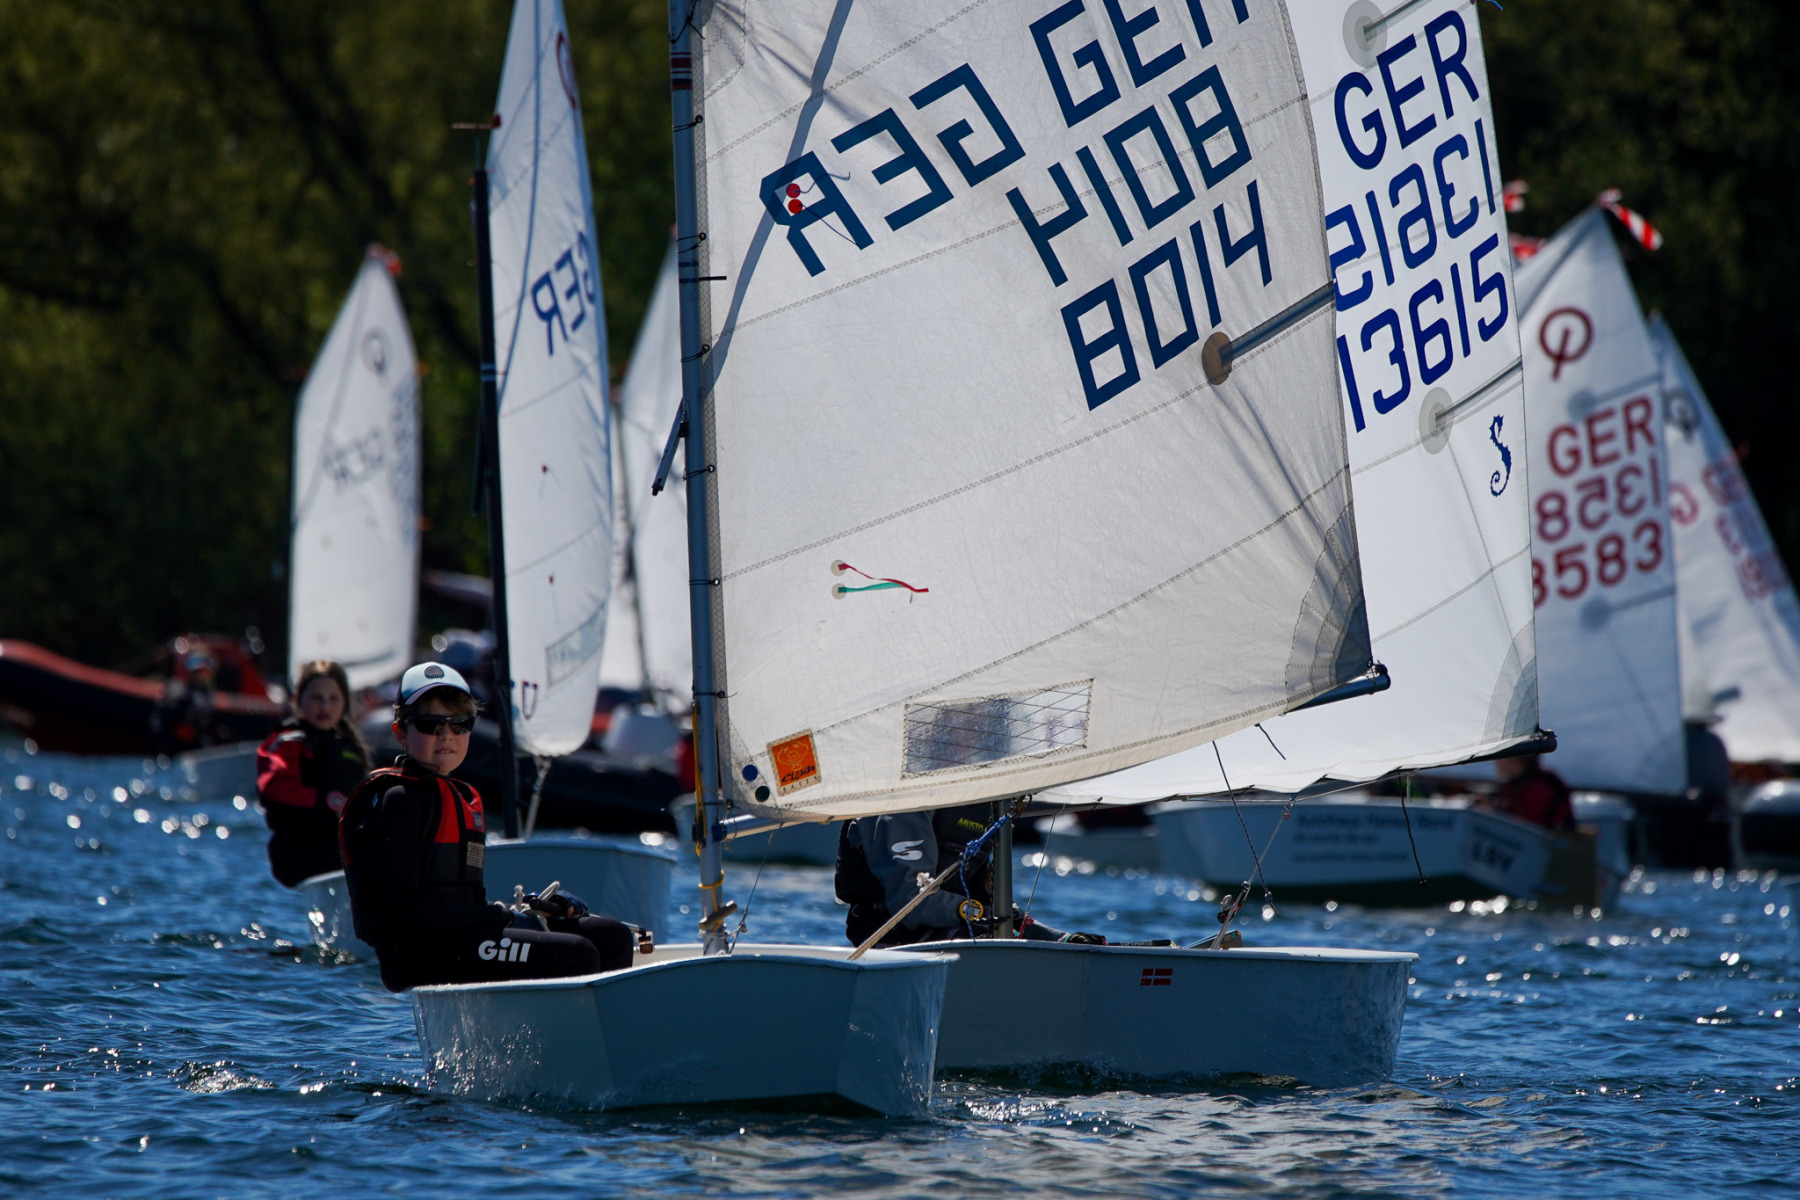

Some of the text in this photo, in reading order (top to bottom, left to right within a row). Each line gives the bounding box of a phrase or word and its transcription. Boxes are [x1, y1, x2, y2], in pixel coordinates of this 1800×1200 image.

[1334, 9, 1480, 170] GER
[1060, 179, 1272, 411] 8014
[1336, 232, 1509, 434] 13615
[1547, 394, 1656, 479] GER
[957, 817, 985, 834] MUSTO
[478, 937, 532, 963] Gill
